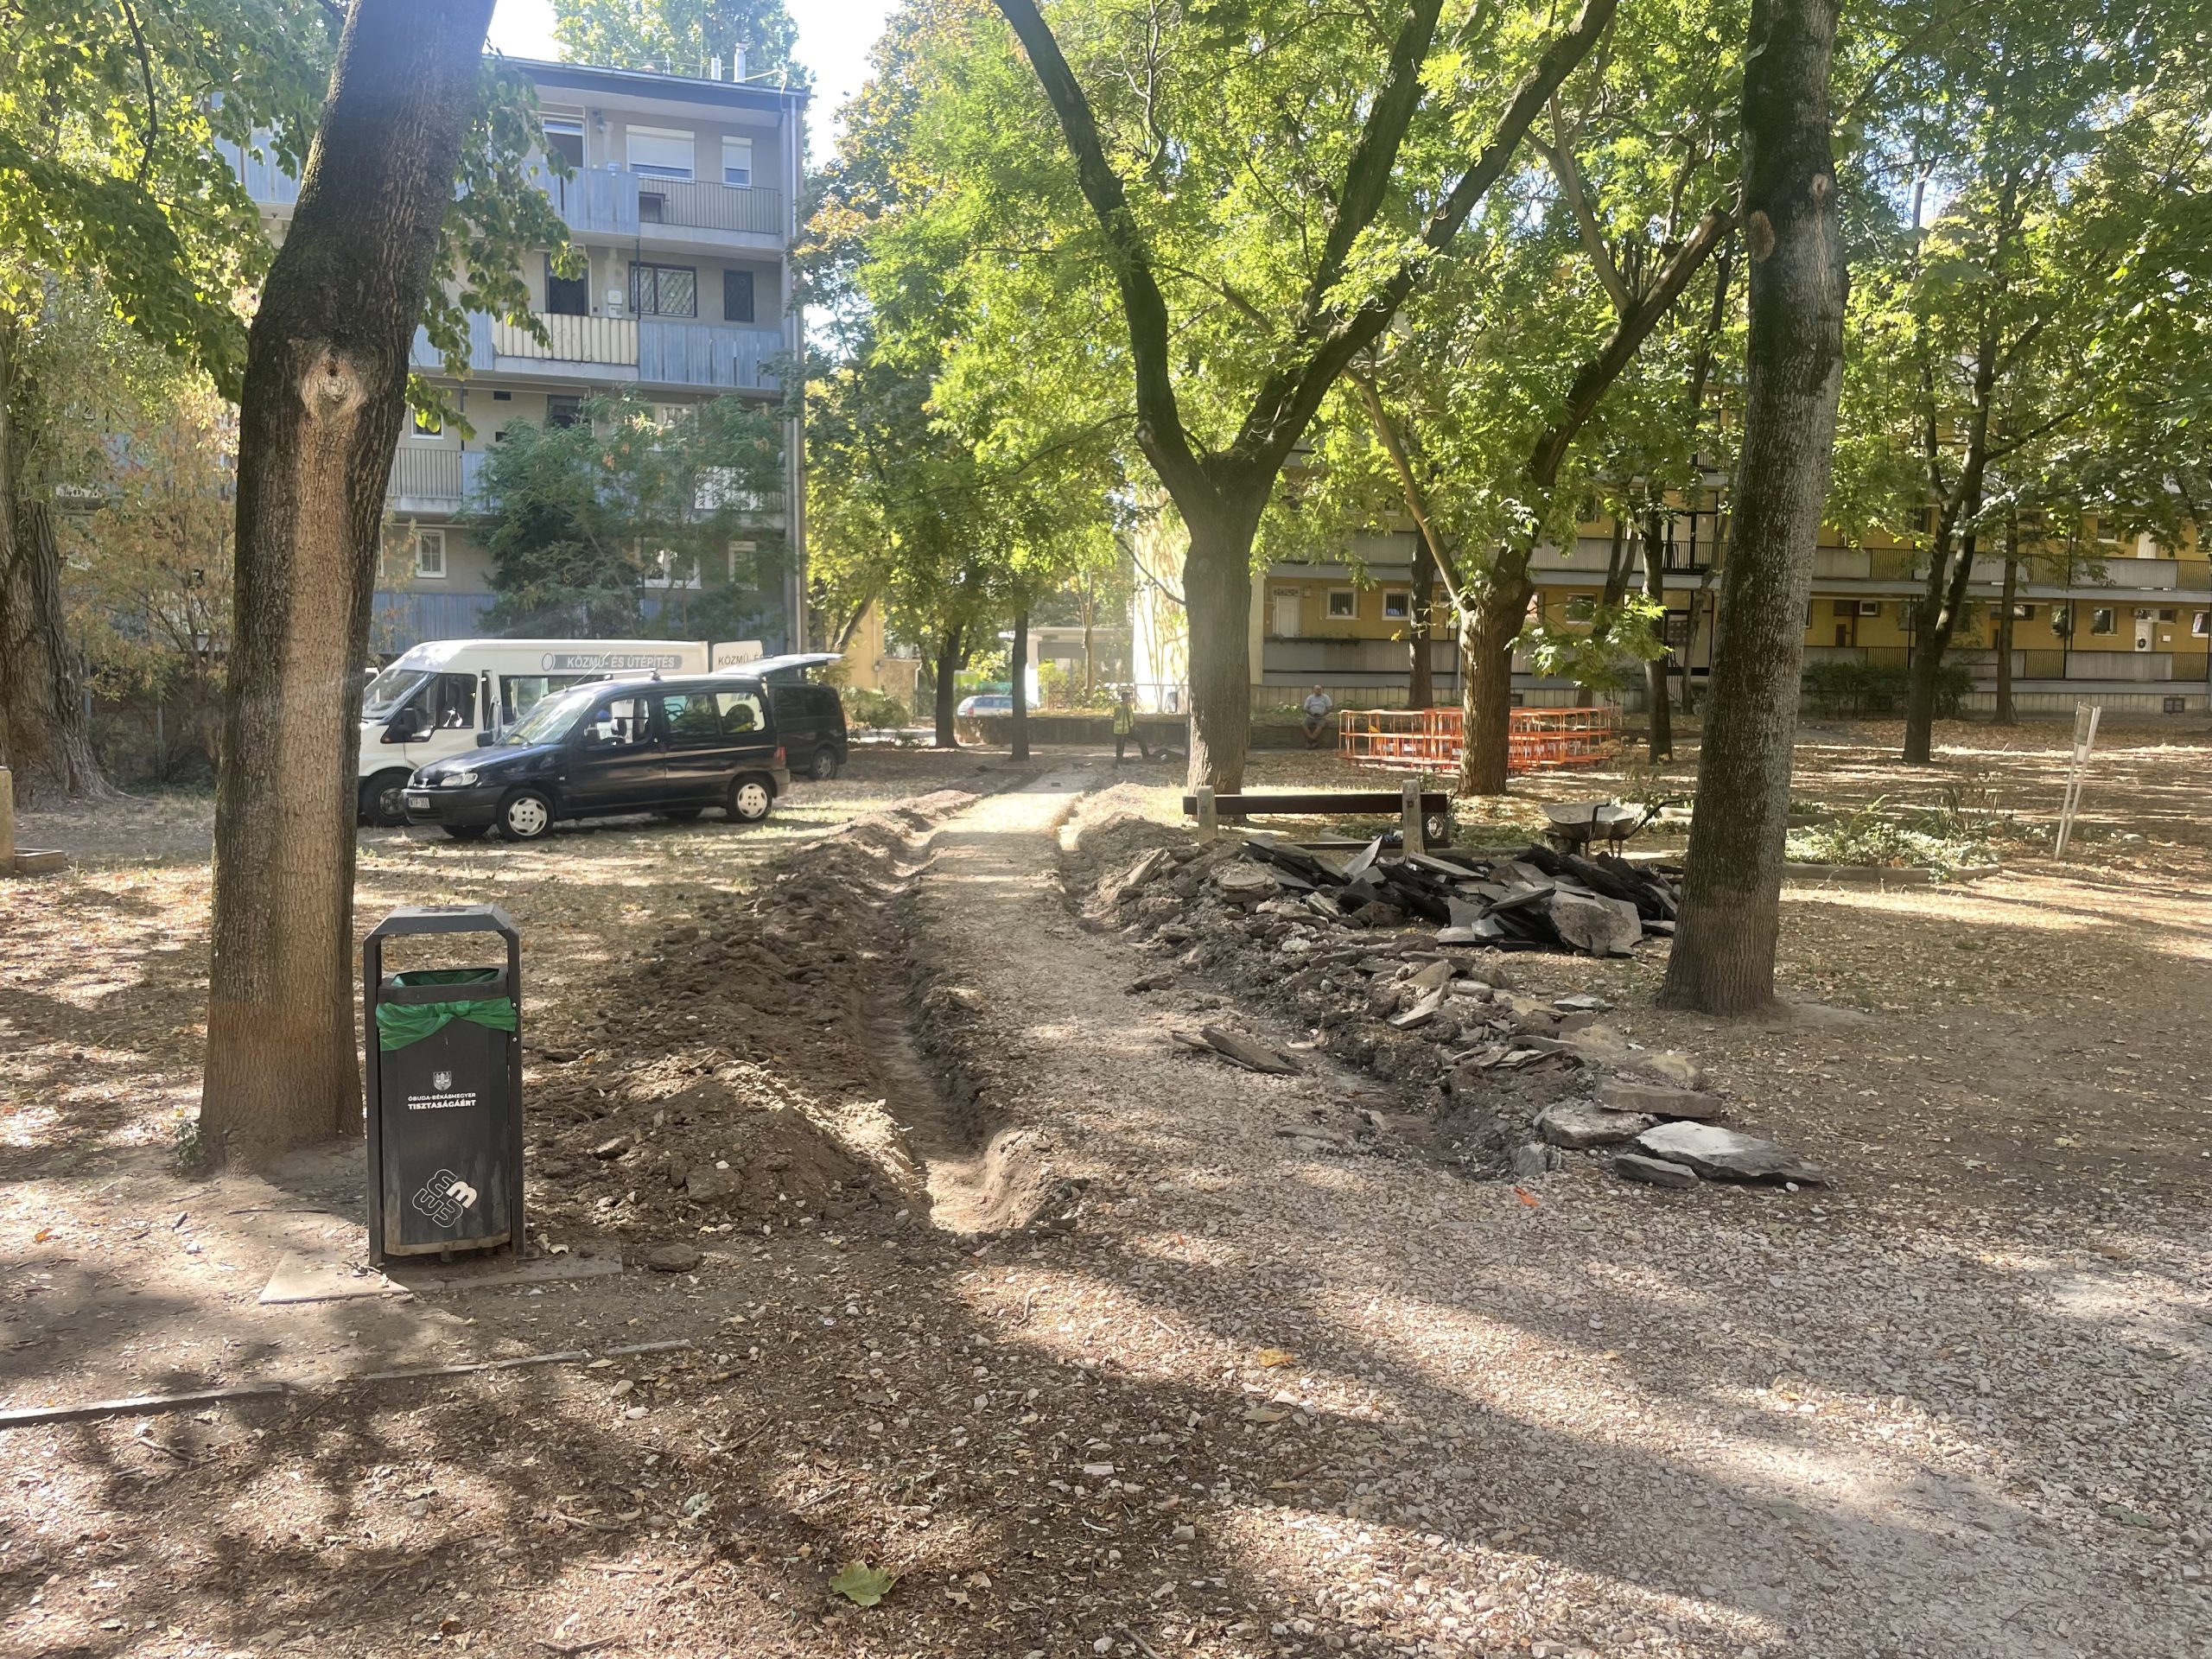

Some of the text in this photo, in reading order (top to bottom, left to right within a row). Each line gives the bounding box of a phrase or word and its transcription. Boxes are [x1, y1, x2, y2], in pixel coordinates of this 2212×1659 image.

[611, 655, 625, 668] ÉS
[627, 654, 675, 668] ÚTÉPÍTÉS
[408, 1092, 477, 1102] ÓBUDA-BÉKÁSMEGYER
[408, 1098, 477, 1110] TISZTASÁGÁÉRT
